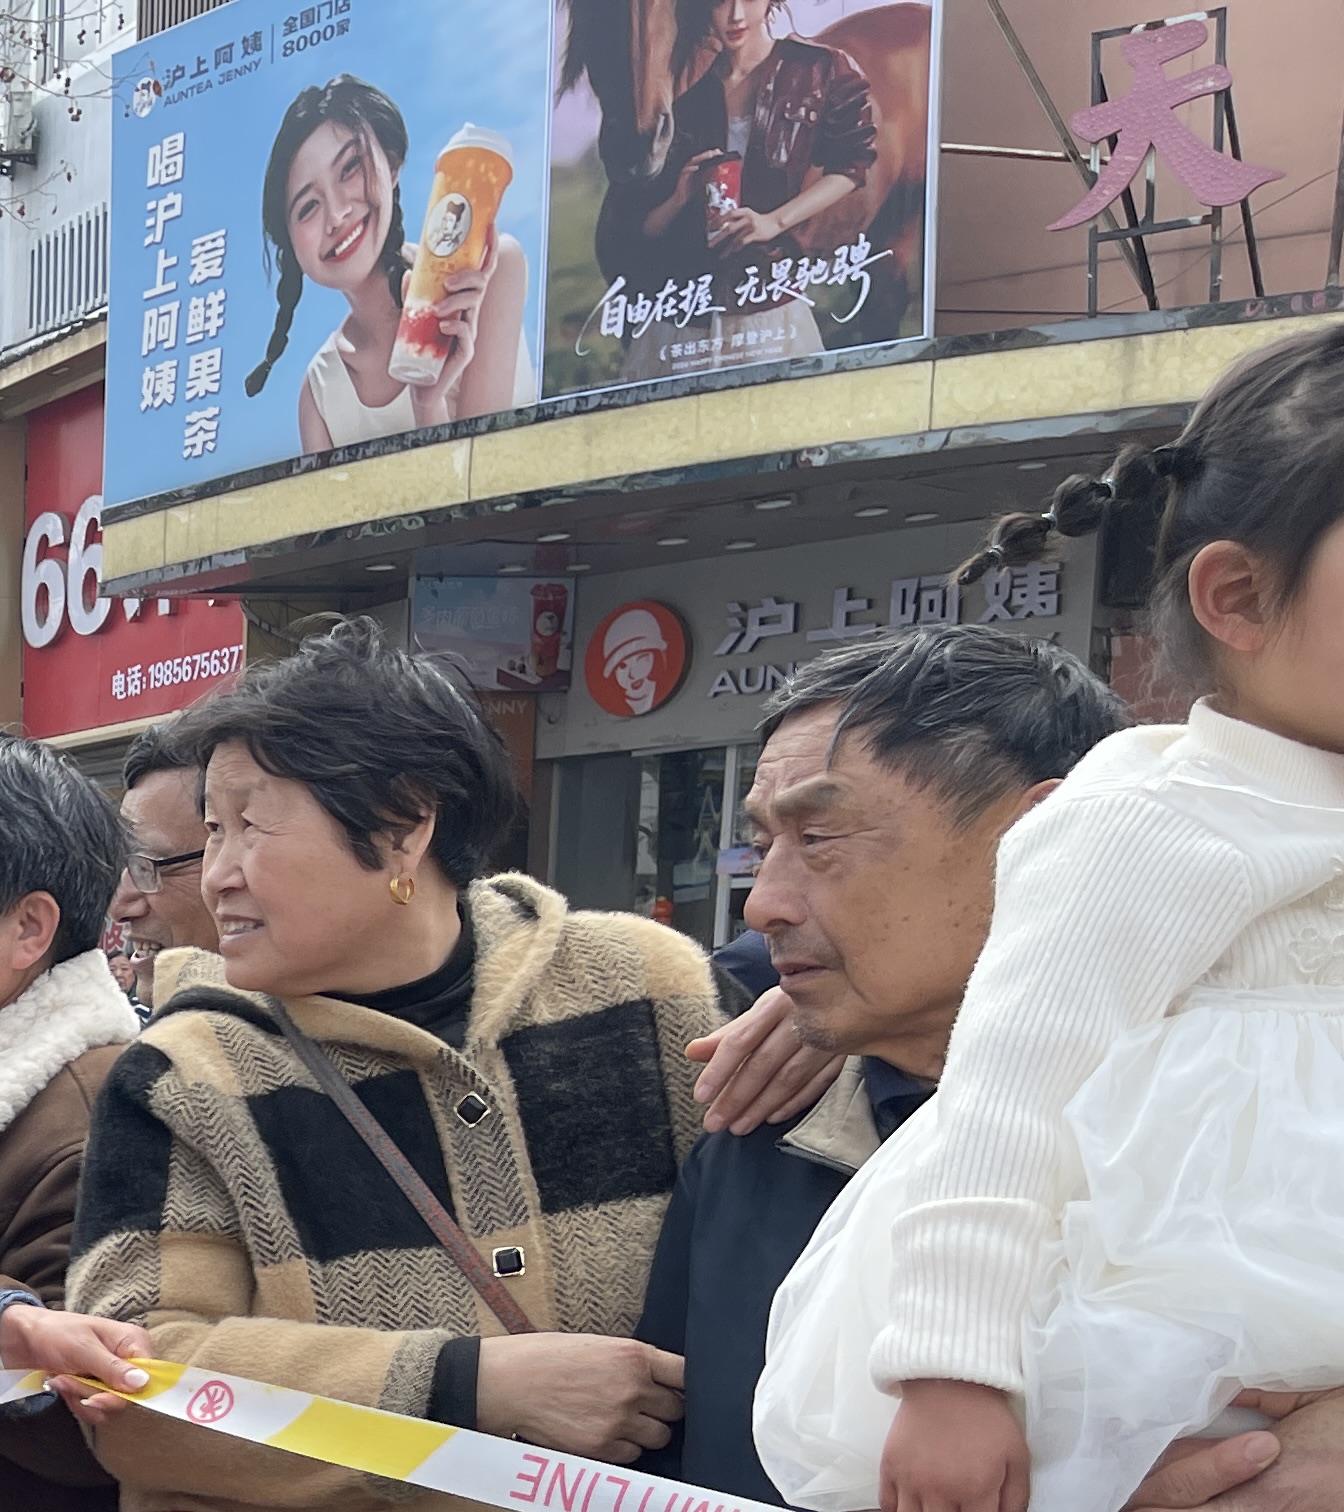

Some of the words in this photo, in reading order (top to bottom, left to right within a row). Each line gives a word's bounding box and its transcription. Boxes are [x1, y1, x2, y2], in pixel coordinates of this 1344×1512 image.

[282, 0, 351, 37] 全国门店
[282, 18, 351, 58] 8000家
[163, 31, 263, 91] 沪上阿姨
[163, 78, 214, 108] AUNTEA
[218, 57, 263, 86] JENNY
[1046, 18, 1286, 232] 天
[139, 131, 185, 413] 喝沪上阿姨
[182, 229, 227, 460] 爱鲜果茶
[576, 274, 726, 356] 自由在握
[714, 562, 1062, 656] 沪上阿姨
